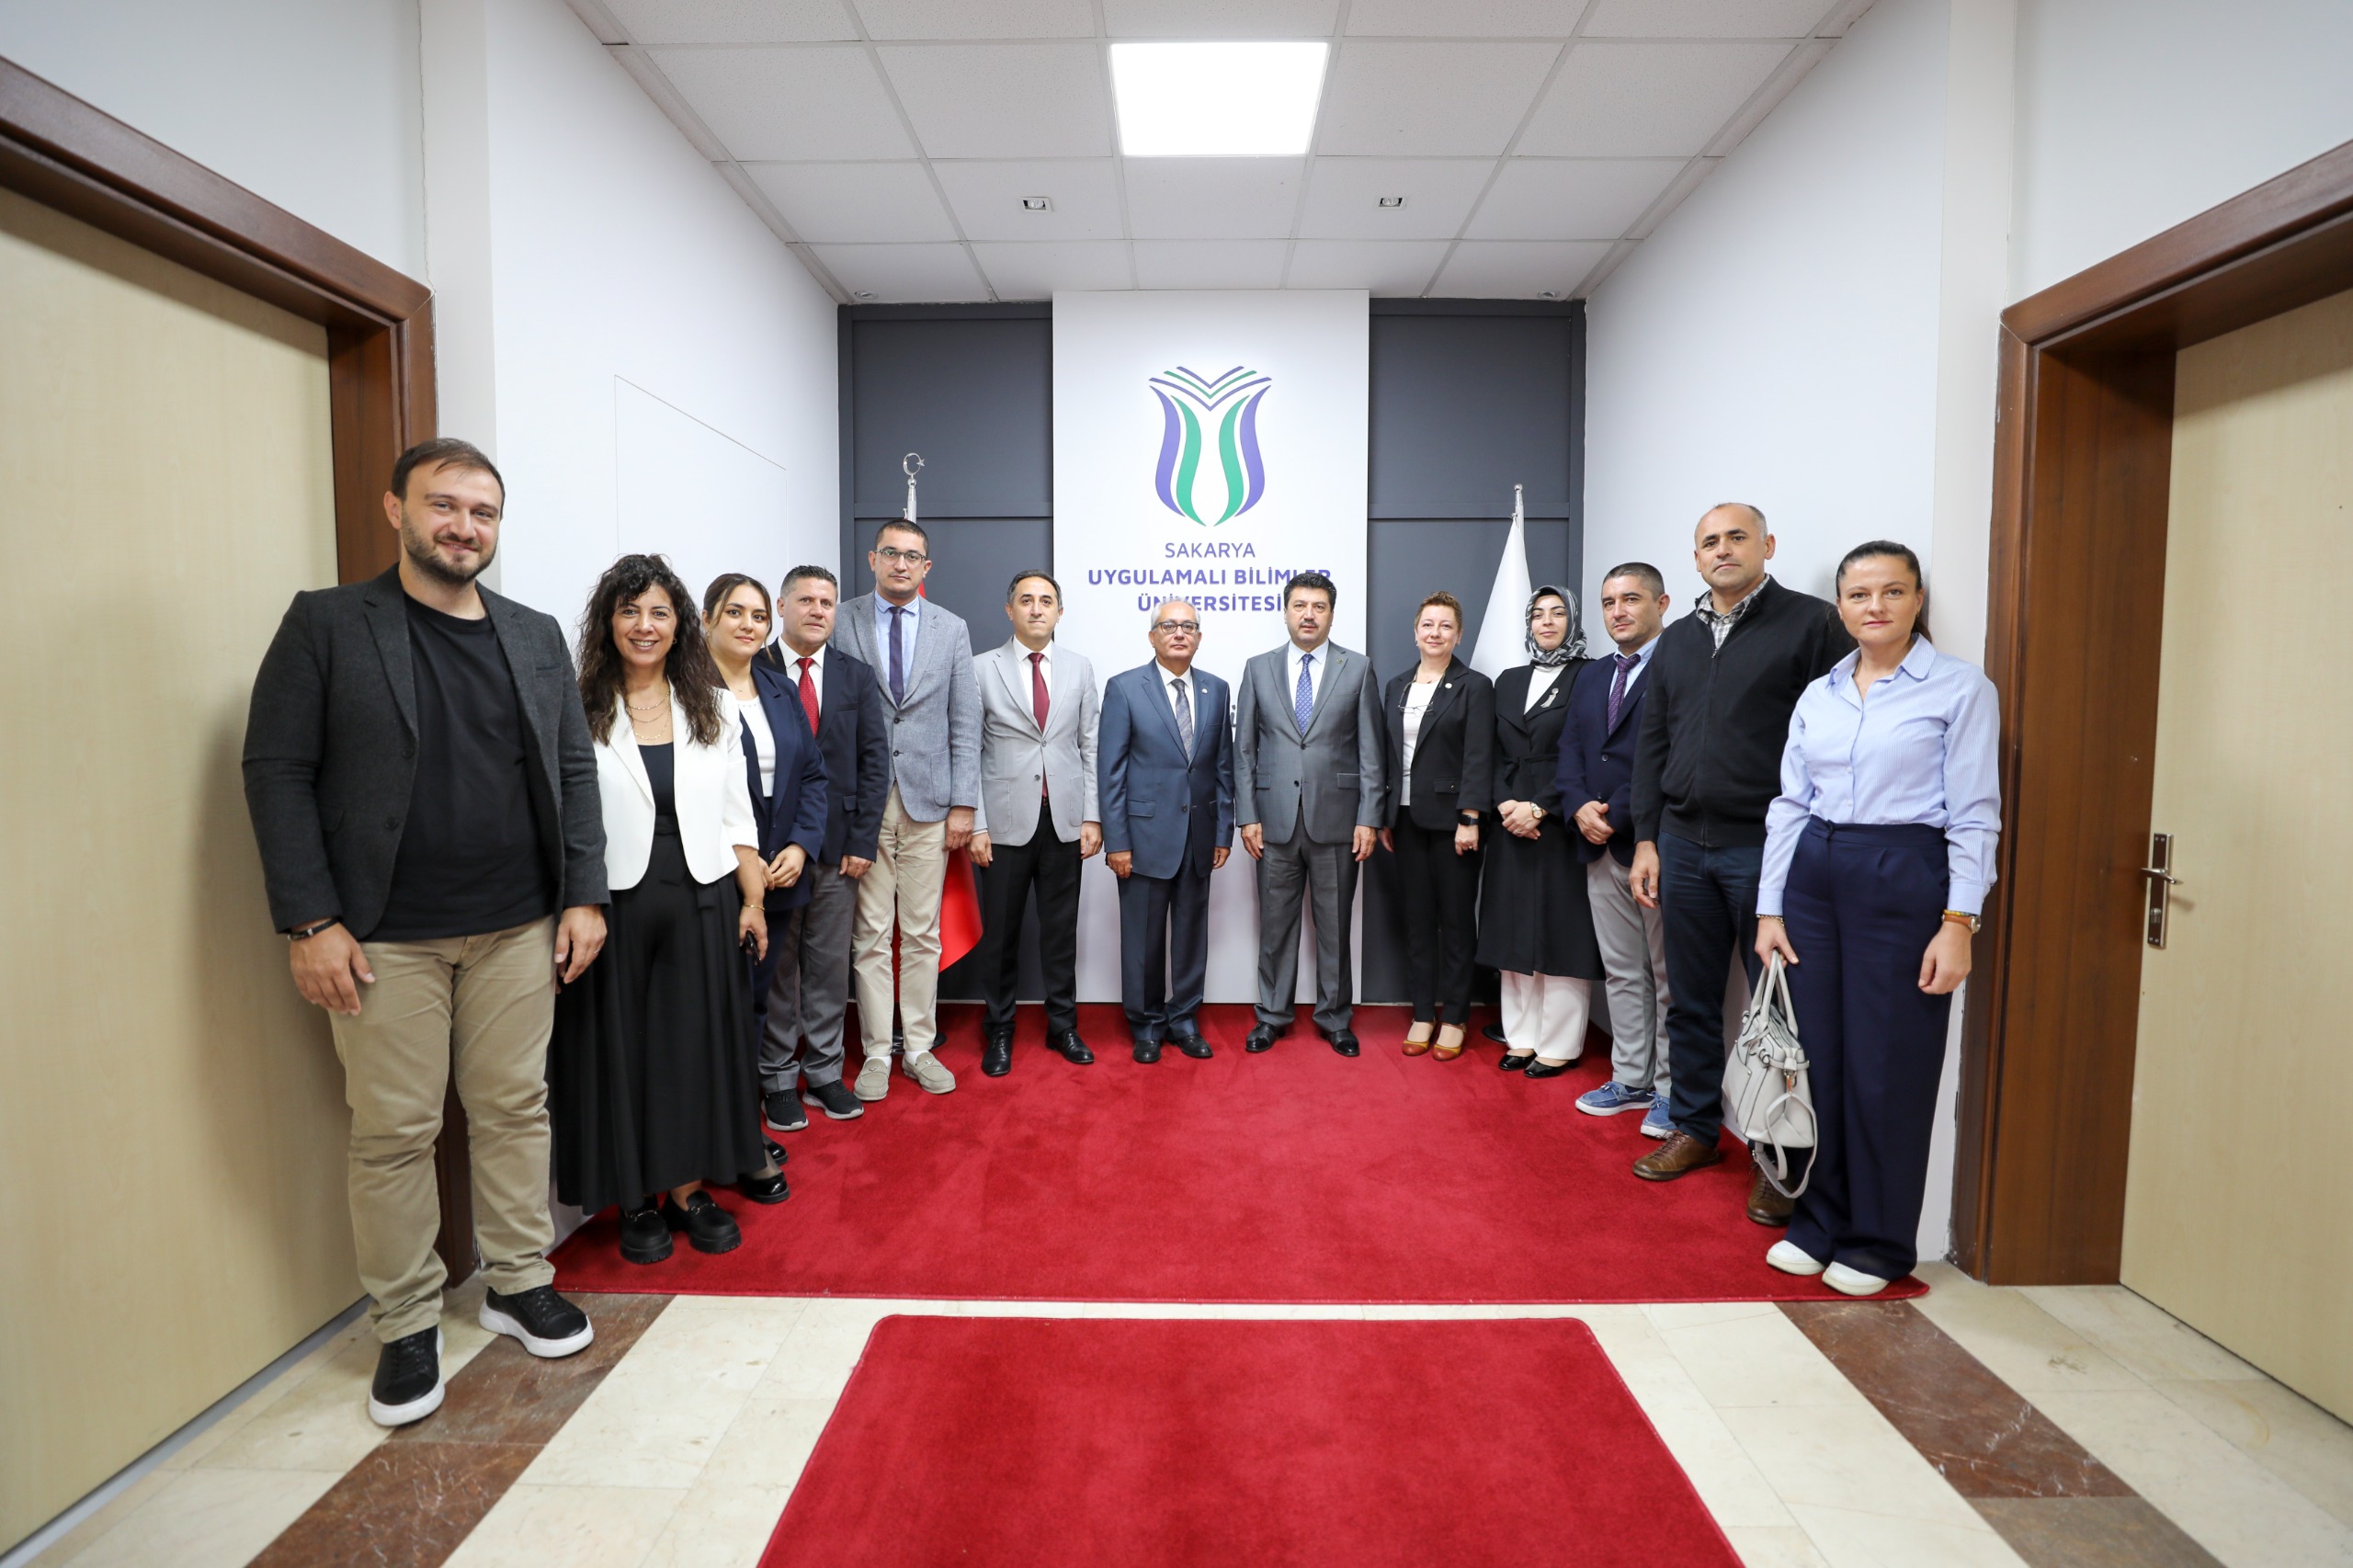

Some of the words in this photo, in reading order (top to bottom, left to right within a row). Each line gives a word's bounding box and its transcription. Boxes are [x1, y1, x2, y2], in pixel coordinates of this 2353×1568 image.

[1165, 542, 1256, 558] SAKARYA
[1088, 569, 1227, 585] UYGULAMALI
[1234, 566, 1331, 585] BİLİM
